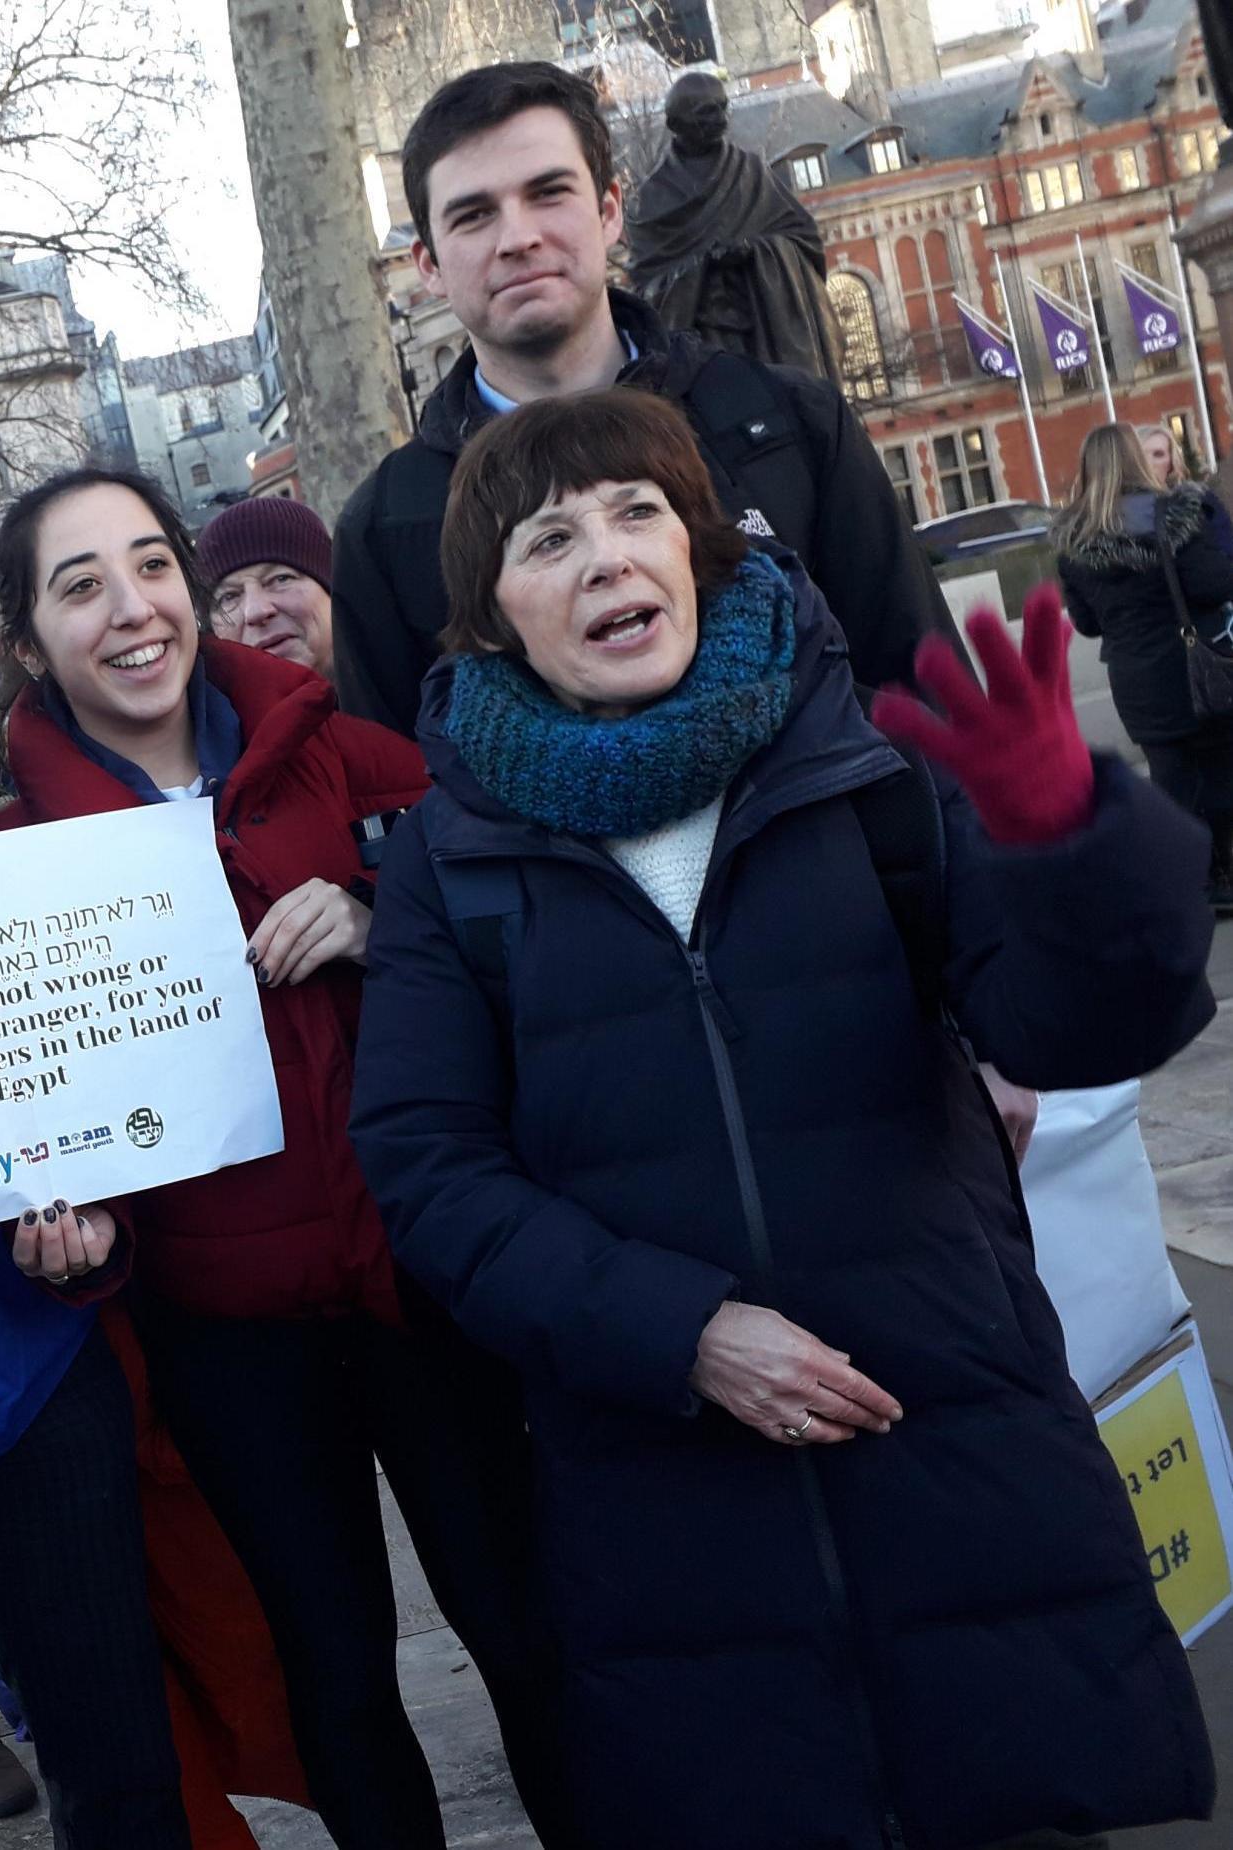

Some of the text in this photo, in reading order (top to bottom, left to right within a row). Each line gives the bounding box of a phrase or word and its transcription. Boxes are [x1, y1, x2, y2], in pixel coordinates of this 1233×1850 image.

[43, 961, 133, 995] wrong
[140, 954, 168, 975] or
[107, 988, 148, 1012] for
[155, 976, 204, 1008] you
[40, 1036, 68, 1059] in
[76, 1025, 123, 1050] the
[129, 1005, 190, 1038] land
[196, 996, 222, 1022] of
[1146, 1437, 1188, 1482] Let
